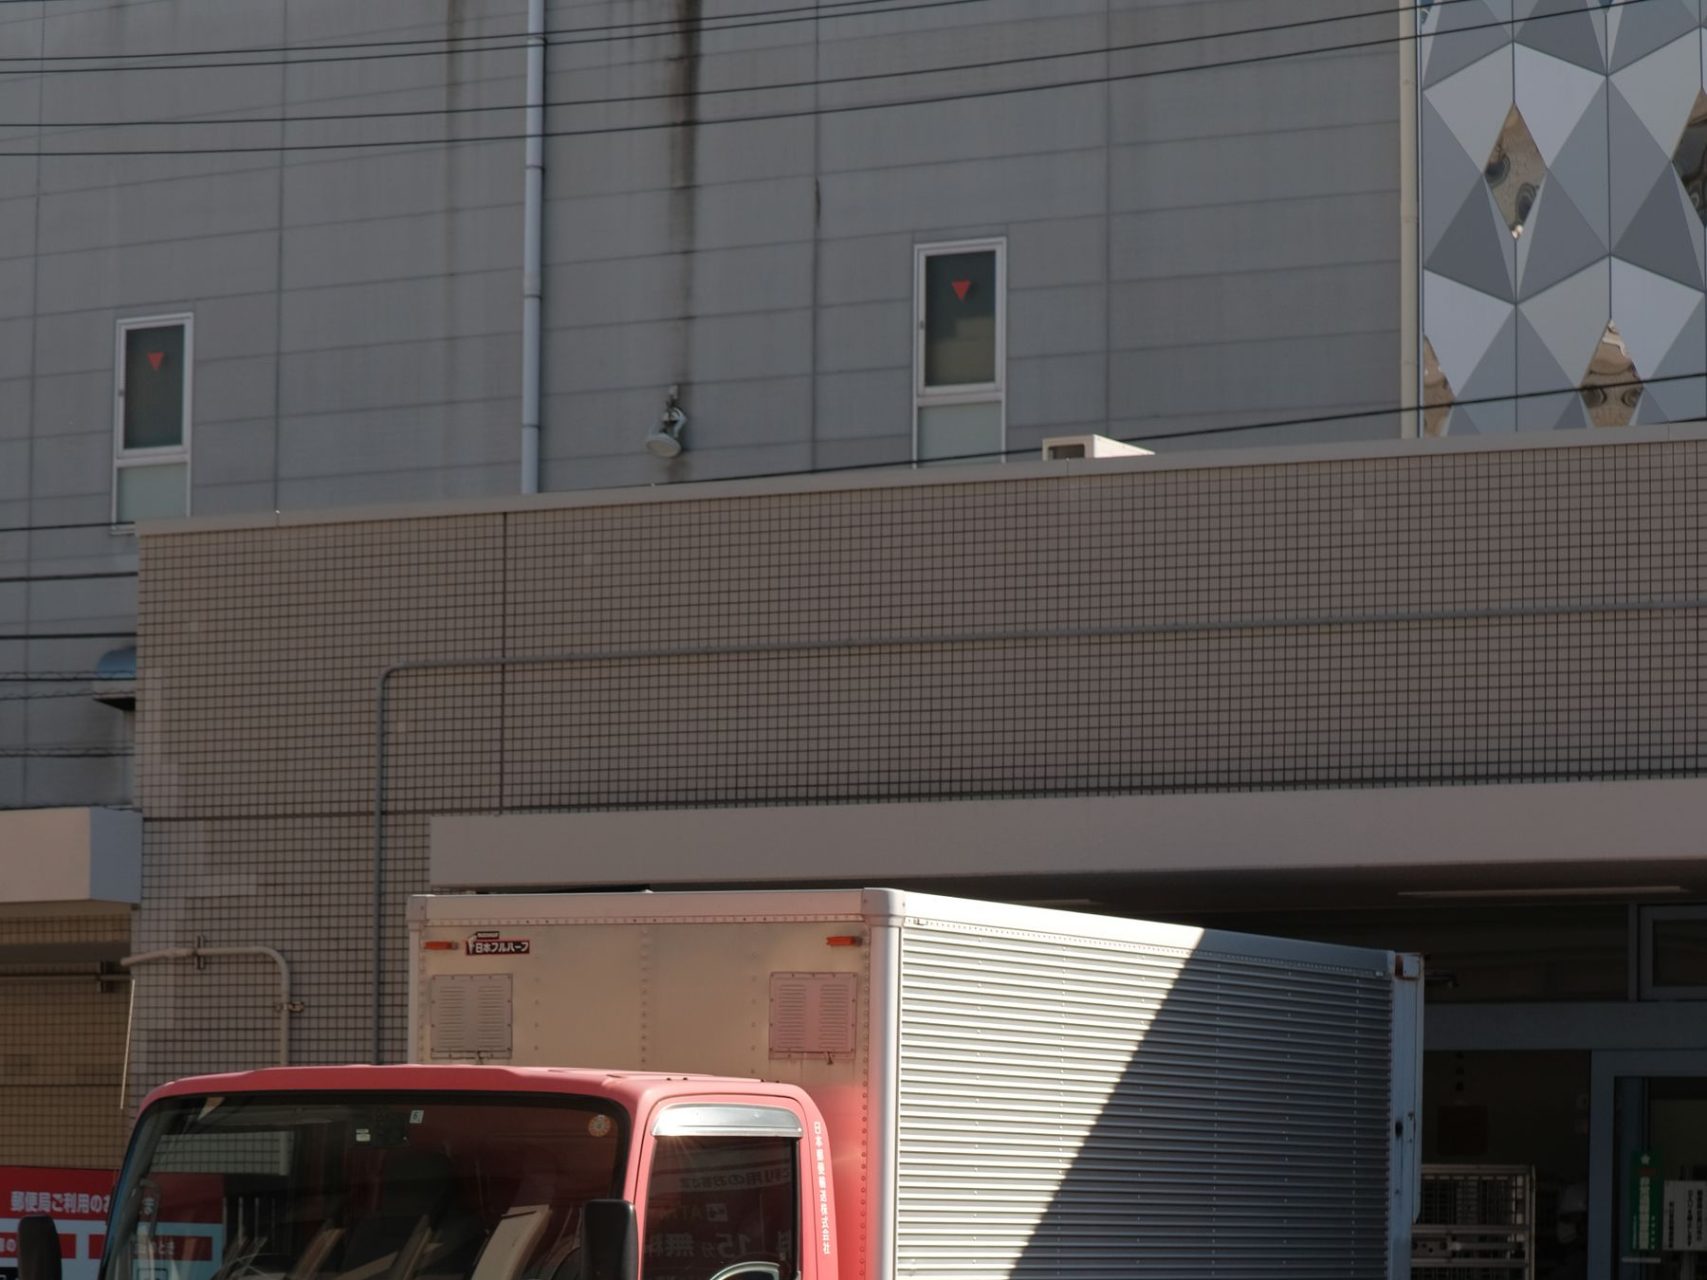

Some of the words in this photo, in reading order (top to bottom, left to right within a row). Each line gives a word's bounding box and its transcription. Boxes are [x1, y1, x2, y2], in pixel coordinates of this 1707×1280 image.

[475, 942, 529, 954] 日本フルハーフ
